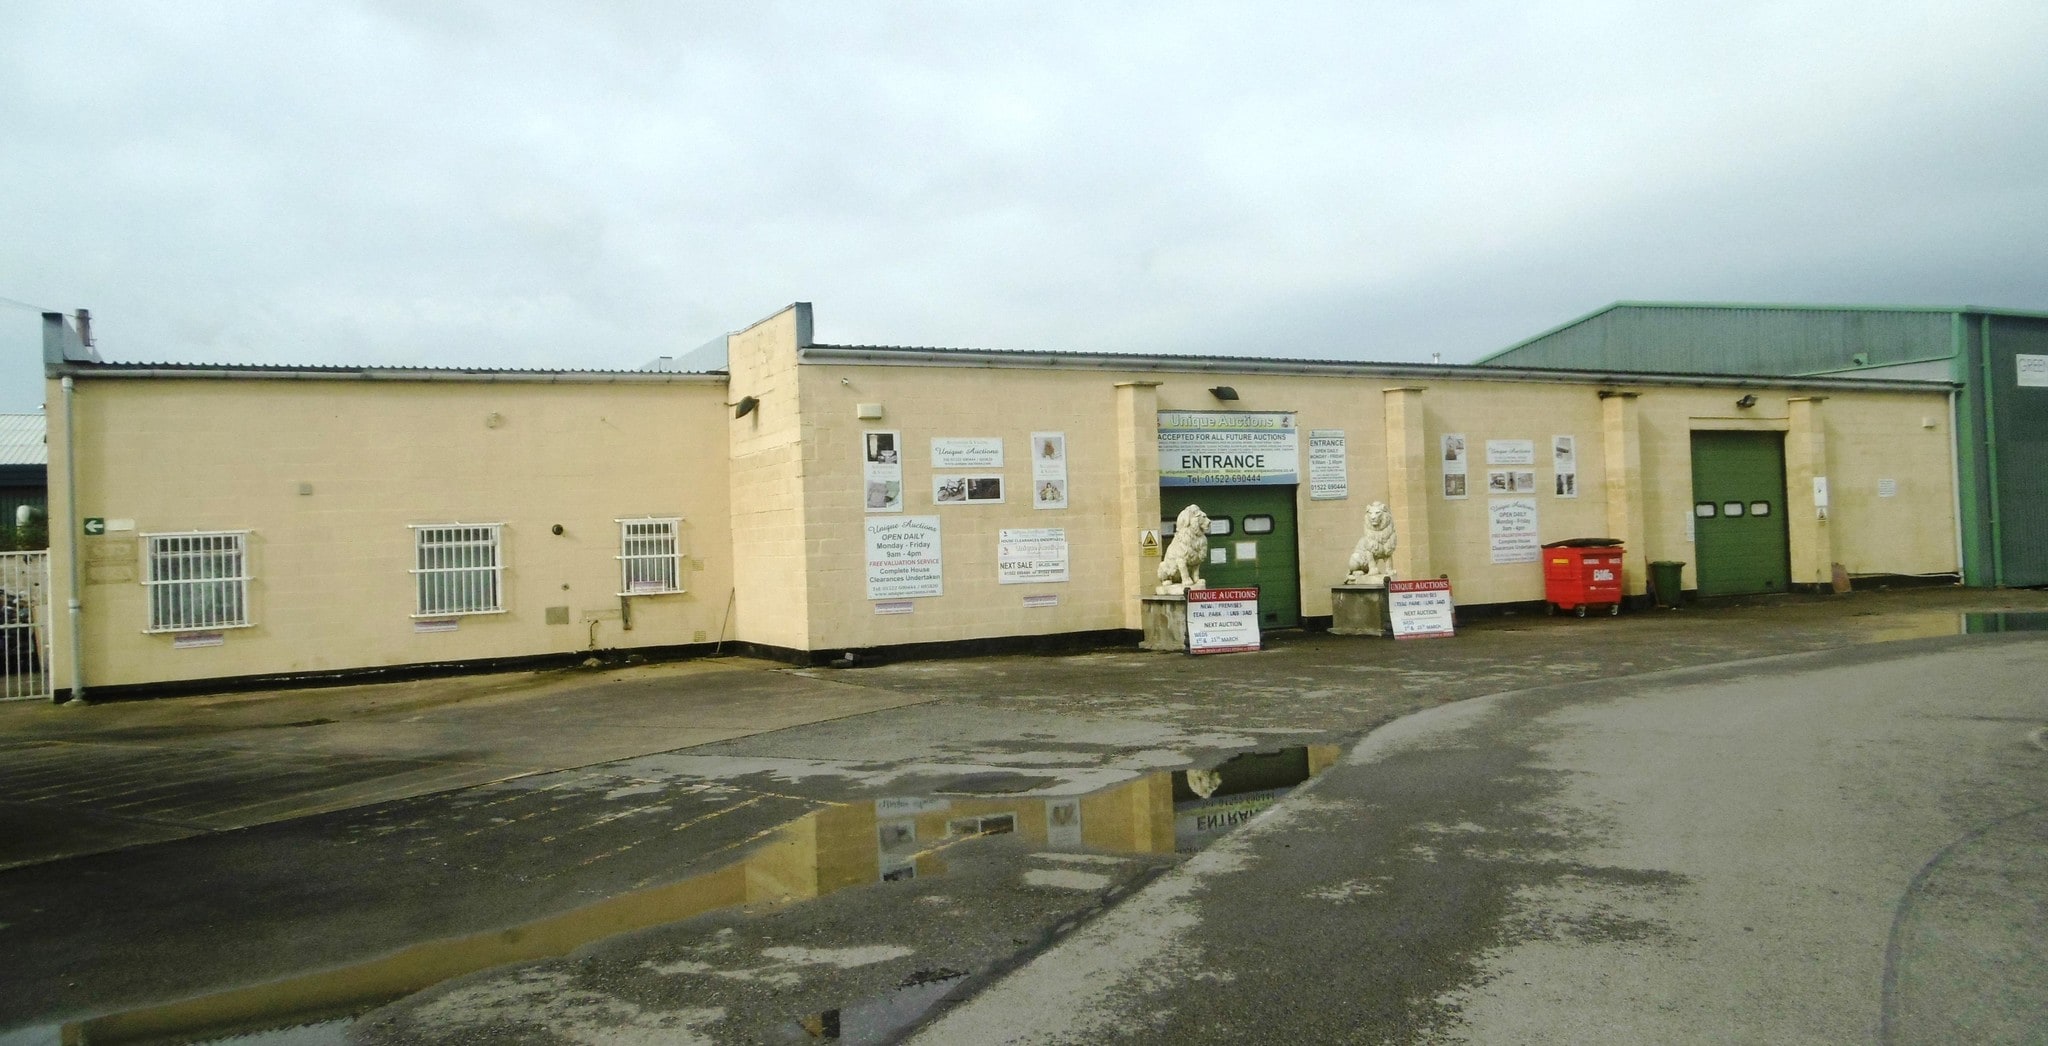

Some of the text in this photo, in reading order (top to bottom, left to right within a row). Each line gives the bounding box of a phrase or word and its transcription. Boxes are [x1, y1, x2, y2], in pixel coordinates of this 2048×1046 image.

[1171, 414, 1274, 429] Unique Auctions
[935, 447, 964, 456] Unique
[1182, 454, 1265, 468] ENTRANCE
[1205, 475, 1229, 483] 01522
[1232, 474, 1261, 482] 690444
[868, 520, 937, 534] Unique Auctions
[1415, 581, 1448, 590] AUCTIONS
[1190, 591, 1256, 600] UNIQUE AUCTIONS
